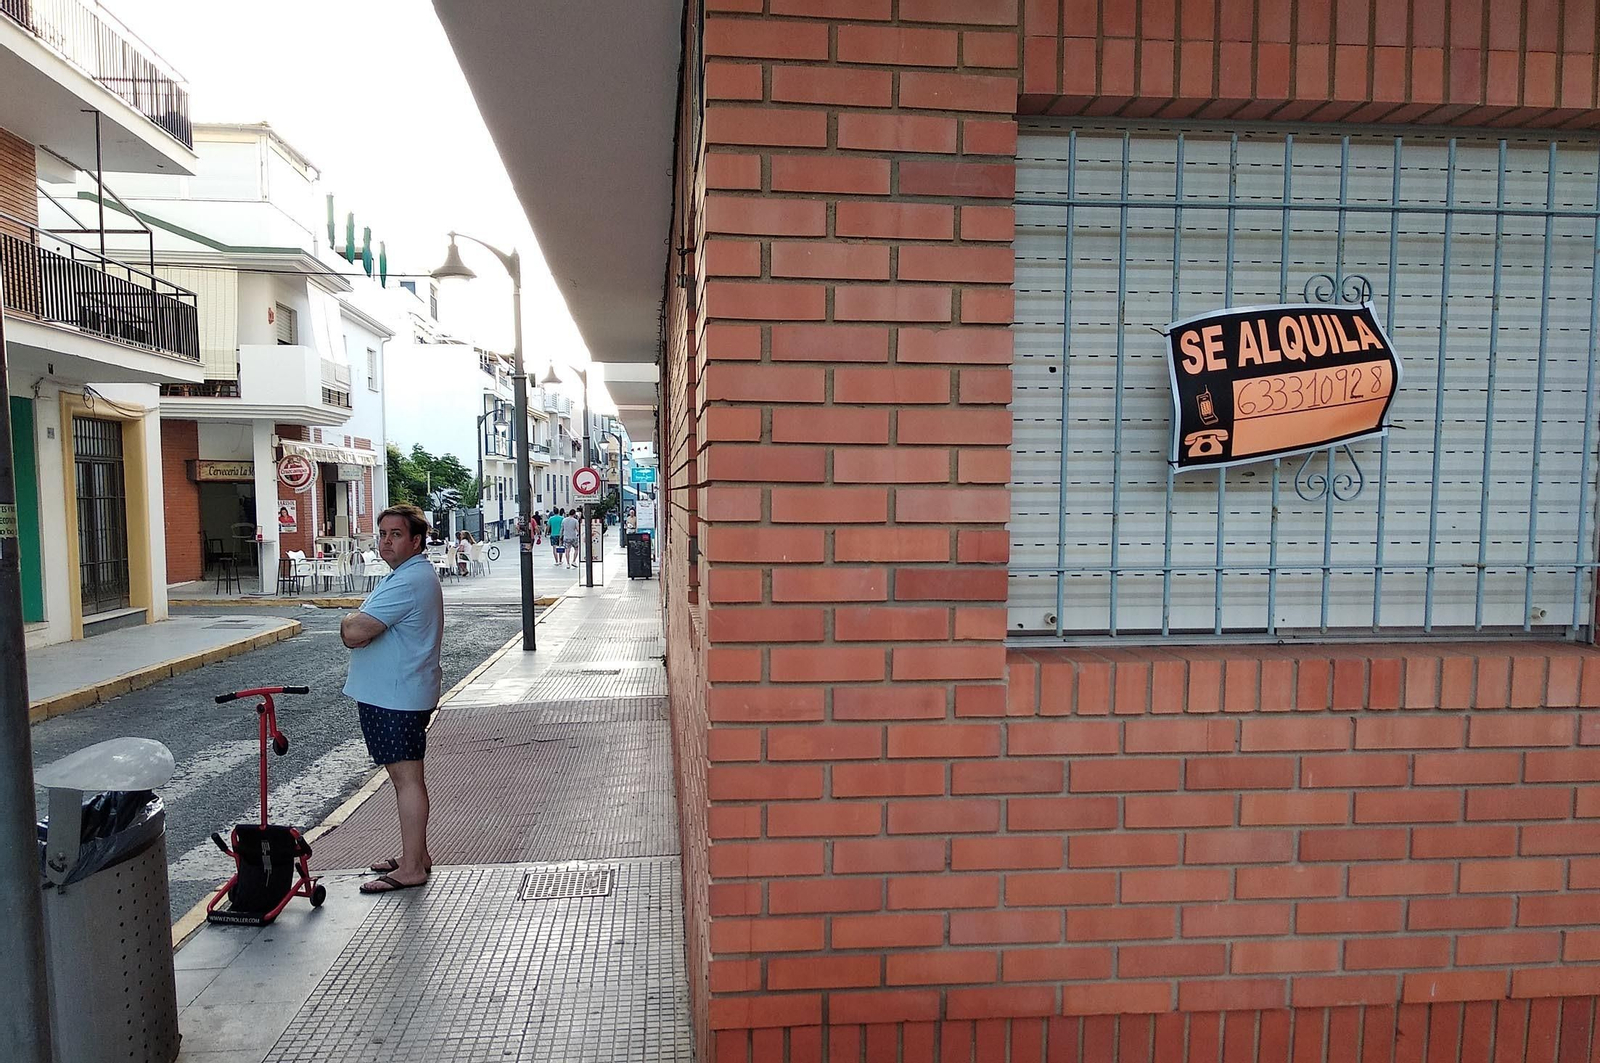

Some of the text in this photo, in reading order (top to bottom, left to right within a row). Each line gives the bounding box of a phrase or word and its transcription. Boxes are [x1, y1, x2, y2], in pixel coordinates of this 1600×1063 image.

[1180, 314, 1384, 375] SE ALQUILA
[1237, 366, 1383, 414] 633310928
